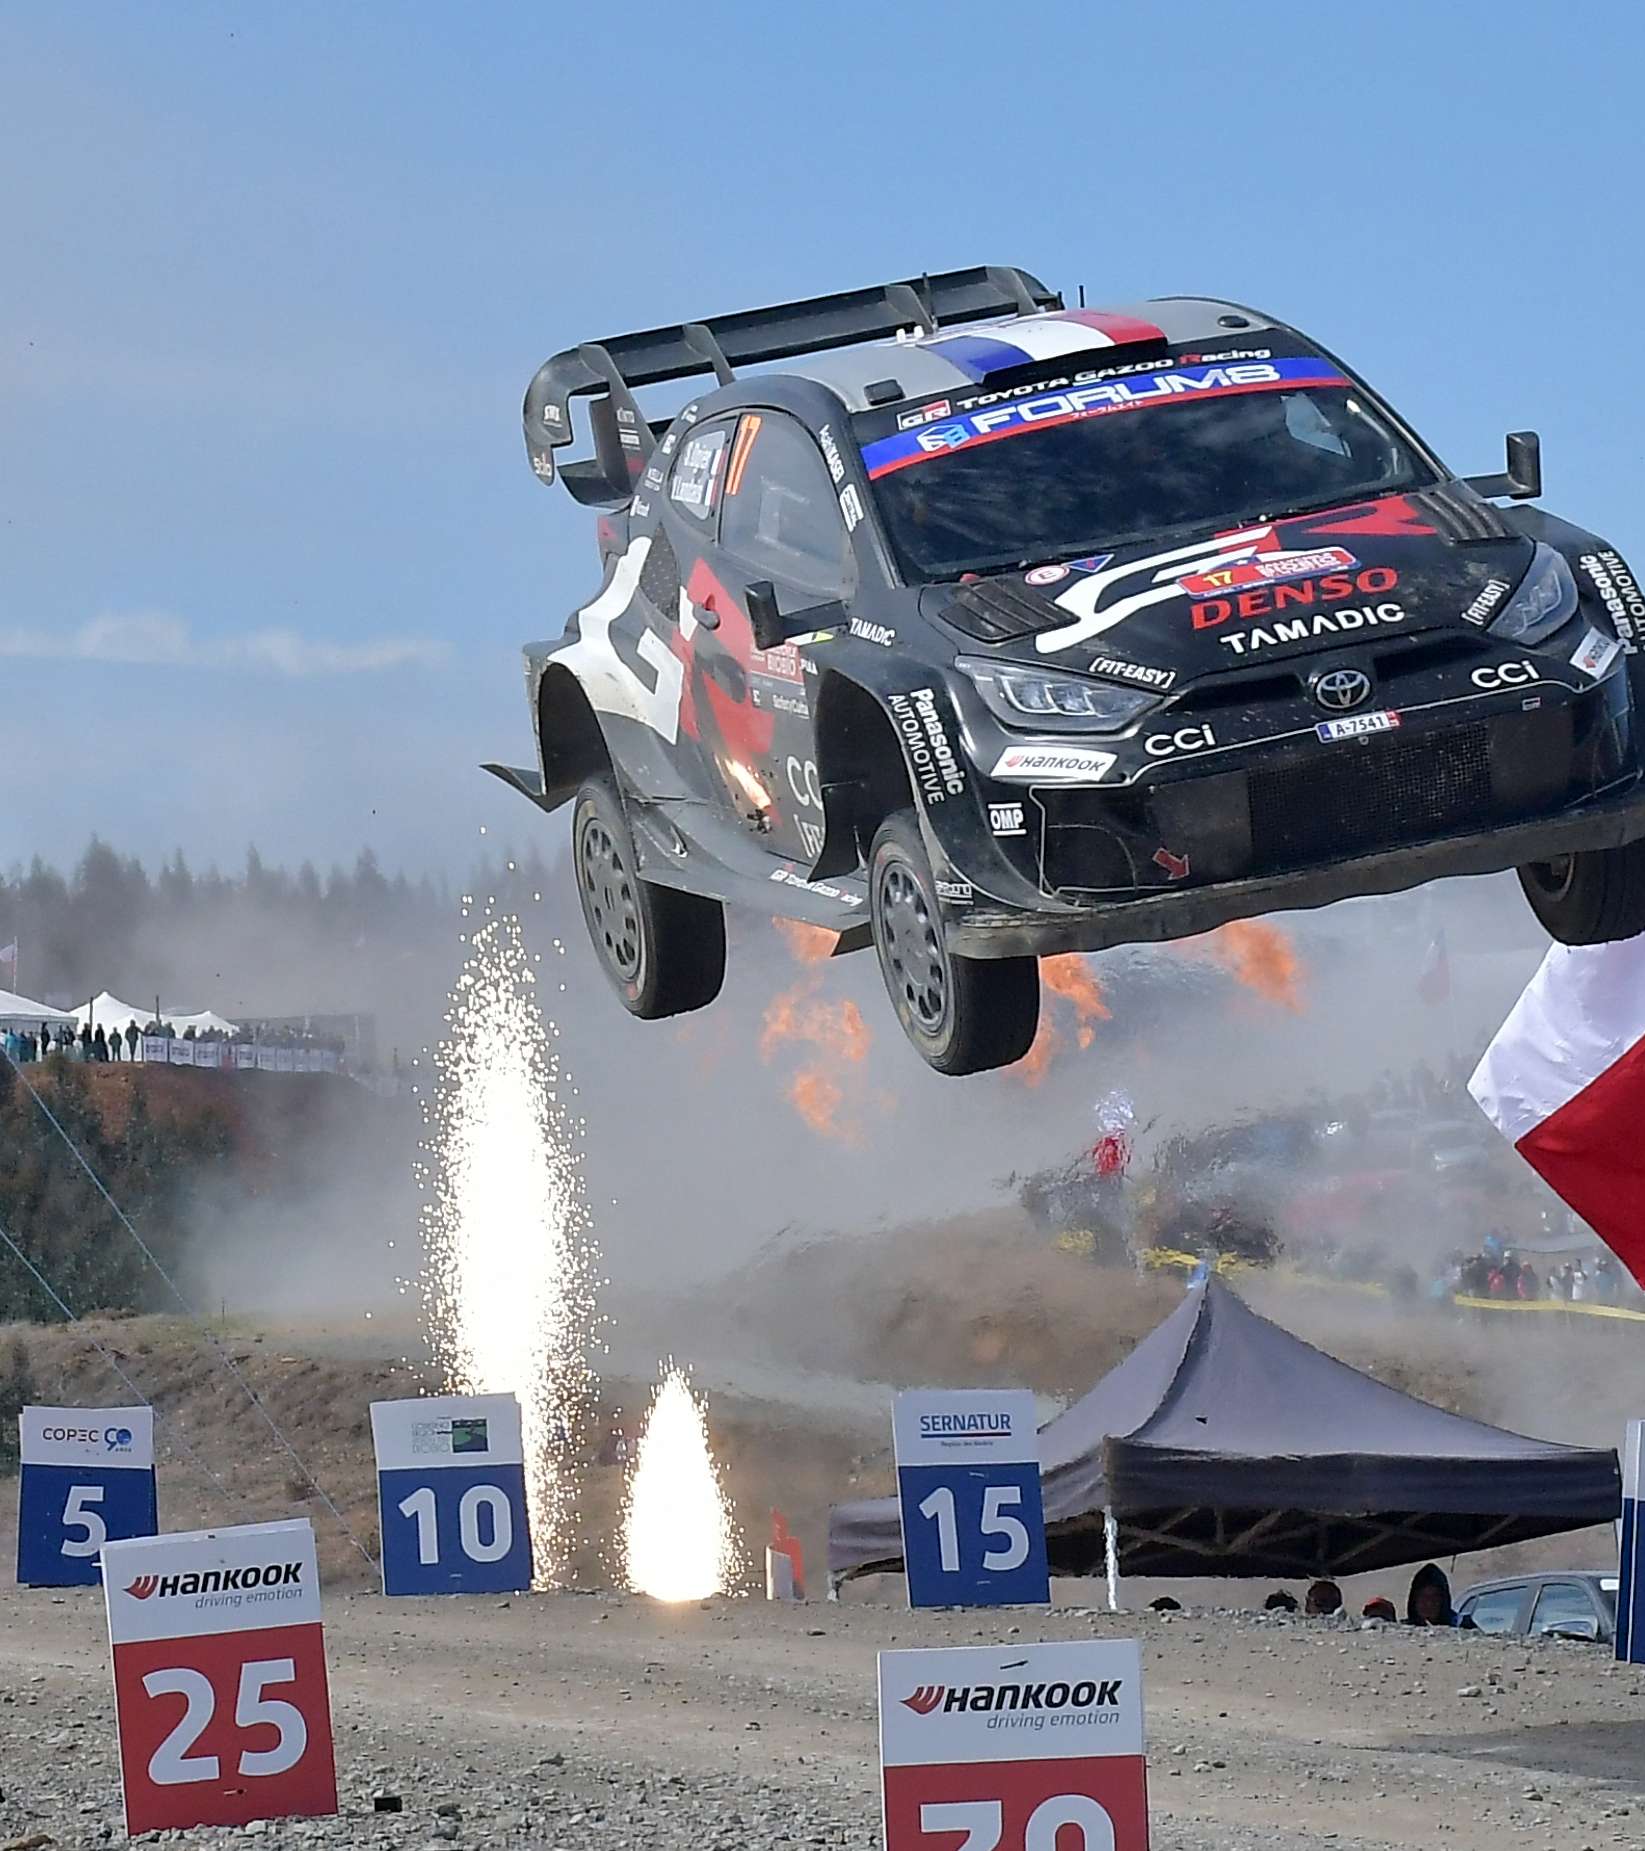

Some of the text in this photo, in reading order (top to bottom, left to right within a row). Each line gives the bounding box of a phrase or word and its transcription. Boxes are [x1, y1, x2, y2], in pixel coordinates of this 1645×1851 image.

[957, 377, 1069, 409] TOYOTA
[1072, 358, 1174, 387] GAZOO
[1178, 347, 1271, 366] Racing
[976, 364, 1281, 434] FORUM8
[726, 415, 763, 496] 17
[1190, 566, 1400, 631] DENSO
[1203, 571, 1234, 587] 17
[1580, 554, 1638, 655] Panasonic
[850, 617, 895, 647] TAMADIC
[1220, 603, 1406, 655] TAMADIC
[888, 694, 945, 805] AUTOMOTIVE
[910, 688, 964, 795] Panasonic
[1336, 716, 1385, 736] A-7541
[991, 808, 1024, 831] OMP
[43, 1427, 99, 1443] COPEC
[920, 1413, 1012, 1434] SERNATUR
[60, 1485, 108, 1557] 5
[397, 1484, 513, 1565] 10
[918, 1485, 1031, 1572] 15
[194, 1587, 303, 1610] driving emotion
[141, 1658, 309, 1786] 25
[987, 1709, 1120, 1732] driving emotion
